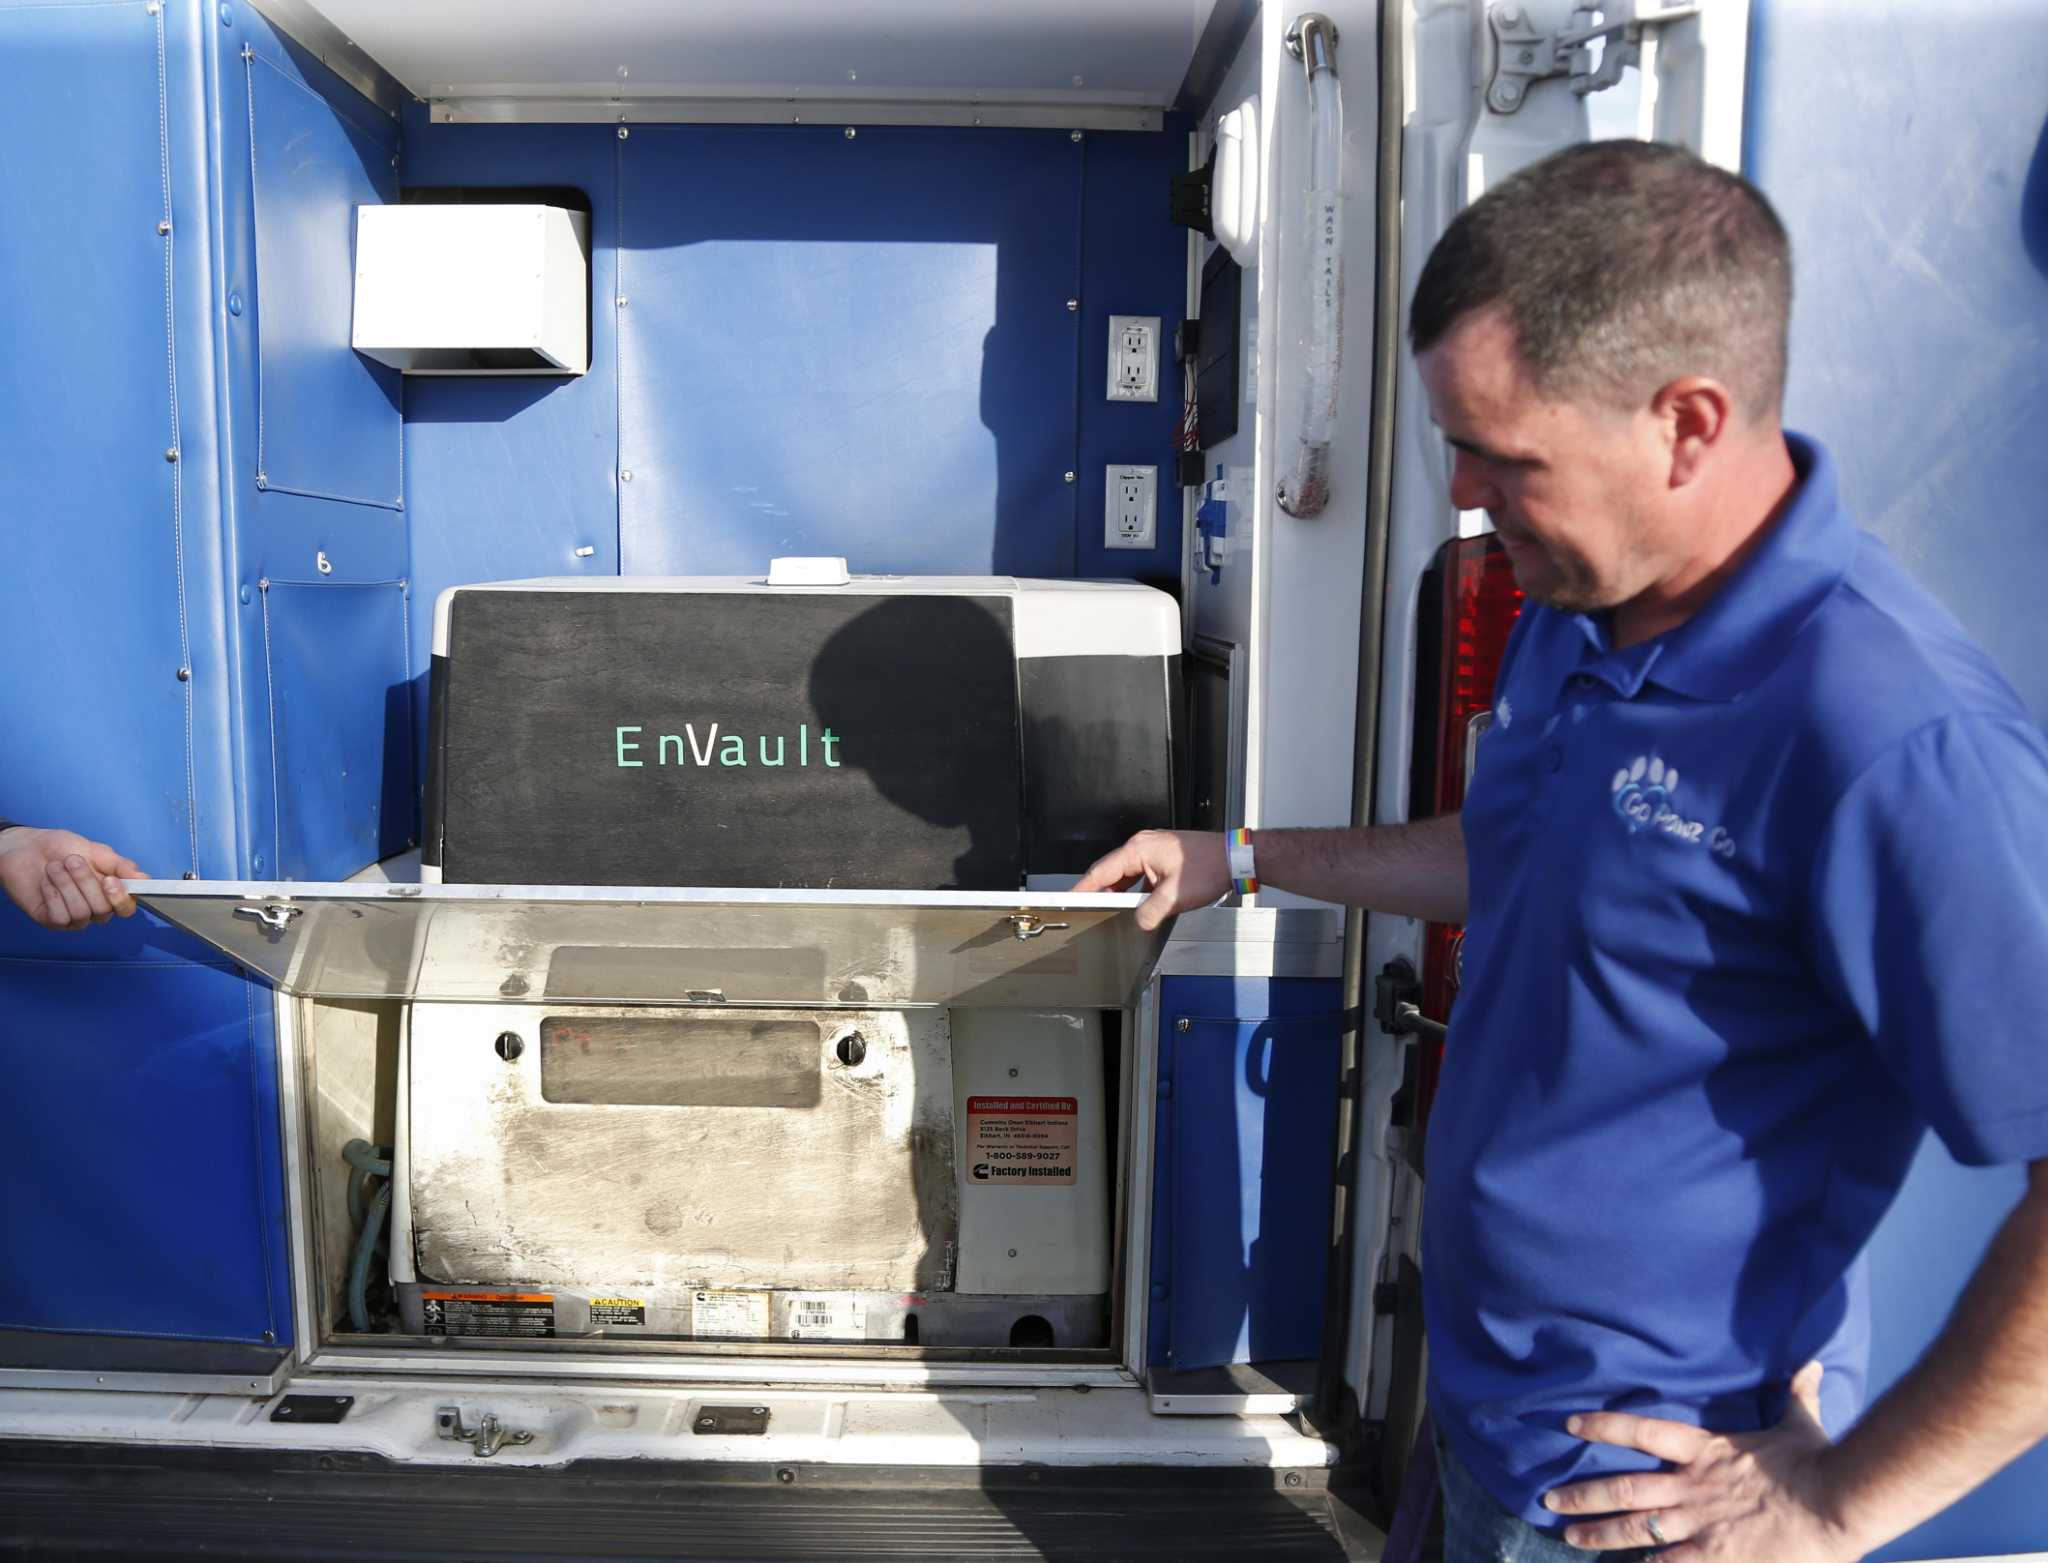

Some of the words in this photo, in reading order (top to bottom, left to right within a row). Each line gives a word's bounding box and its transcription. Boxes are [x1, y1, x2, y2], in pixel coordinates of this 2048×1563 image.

[1324, 257, 1333, 307] TAILS
[616, 723, 840, 767] EnVault
[974, 1101, 1009, 1110] Installed
[1009, 1102, 1024, 1110] and
[1025, 1102, 1060, 1111] Certified
[985, 1152, 1060, 1160] 1-800-589-9027
[991, 1166, 1027, 1177] Factory
[1028, 1166, 1072, 1177] Installed
